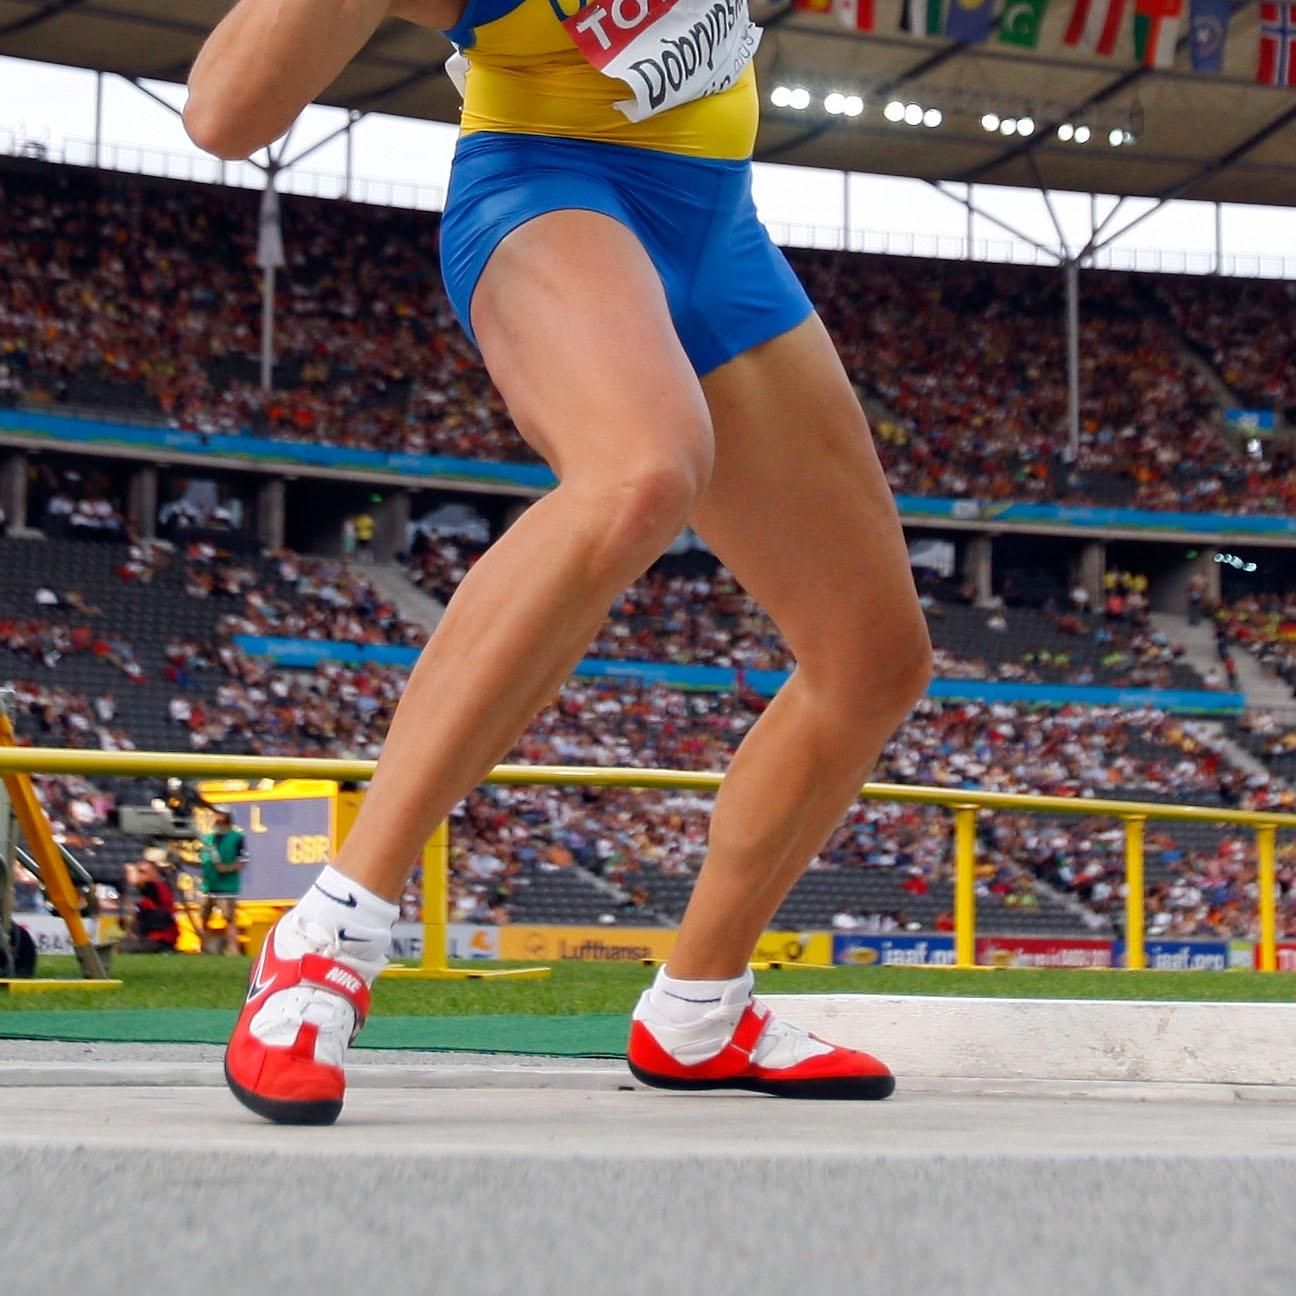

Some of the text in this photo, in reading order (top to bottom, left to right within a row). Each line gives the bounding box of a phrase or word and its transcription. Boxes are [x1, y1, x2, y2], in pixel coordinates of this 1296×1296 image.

[559, 939, 653, 960] Lufthansa
[884, 941, 957, 966] iaaf.or
[324, 966, 363, 995] NIKE
